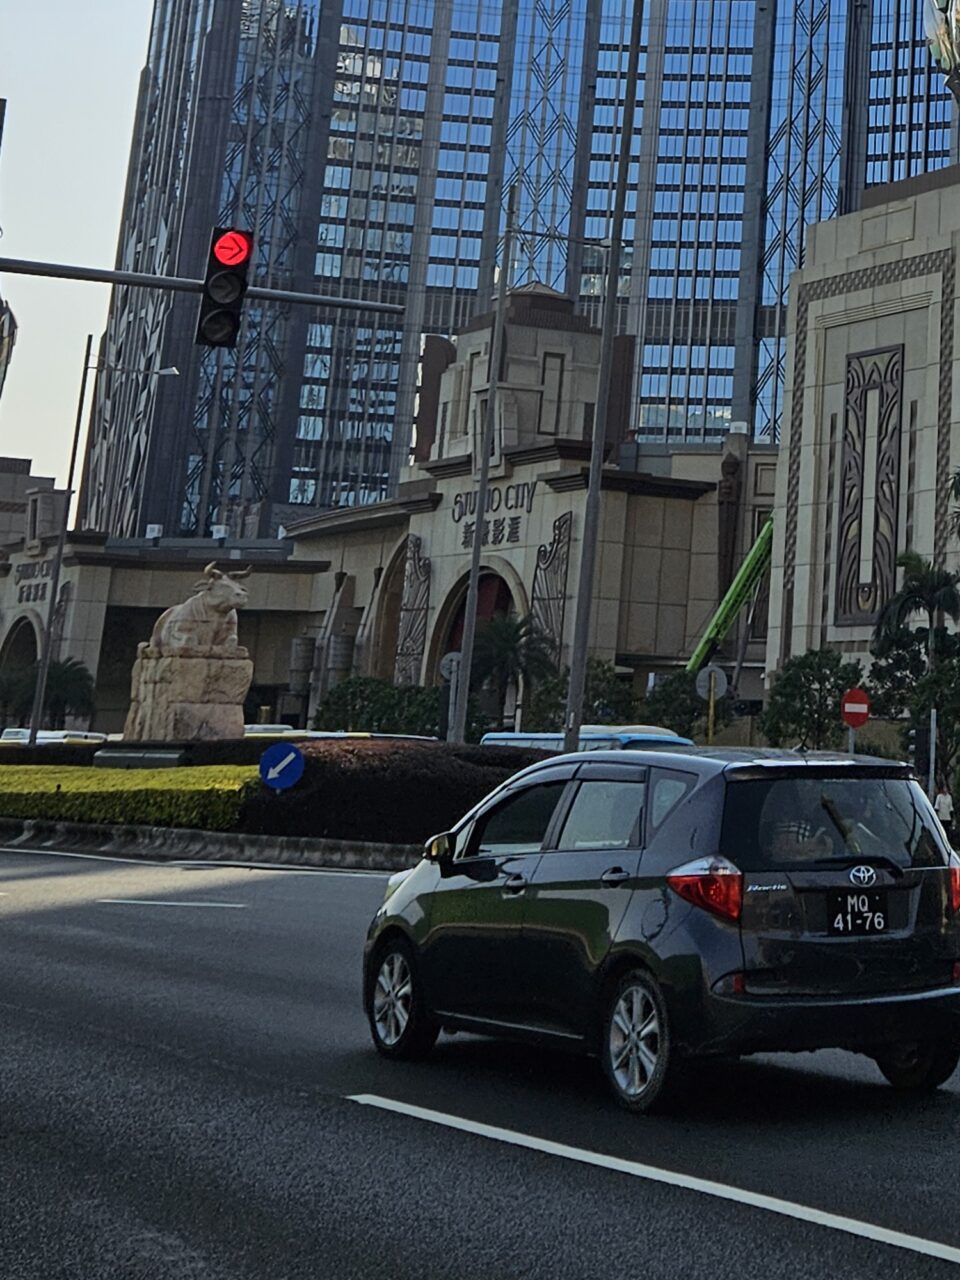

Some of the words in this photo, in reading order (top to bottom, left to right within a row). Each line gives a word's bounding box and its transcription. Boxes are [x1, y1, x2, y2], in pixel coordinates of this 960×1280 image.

[452, 487, 502, 524] STUIO
[505, 481, 537, 513] CITY
[847, 895, 869, 913] MQ
[833, 912, 885, 931] 41-76
